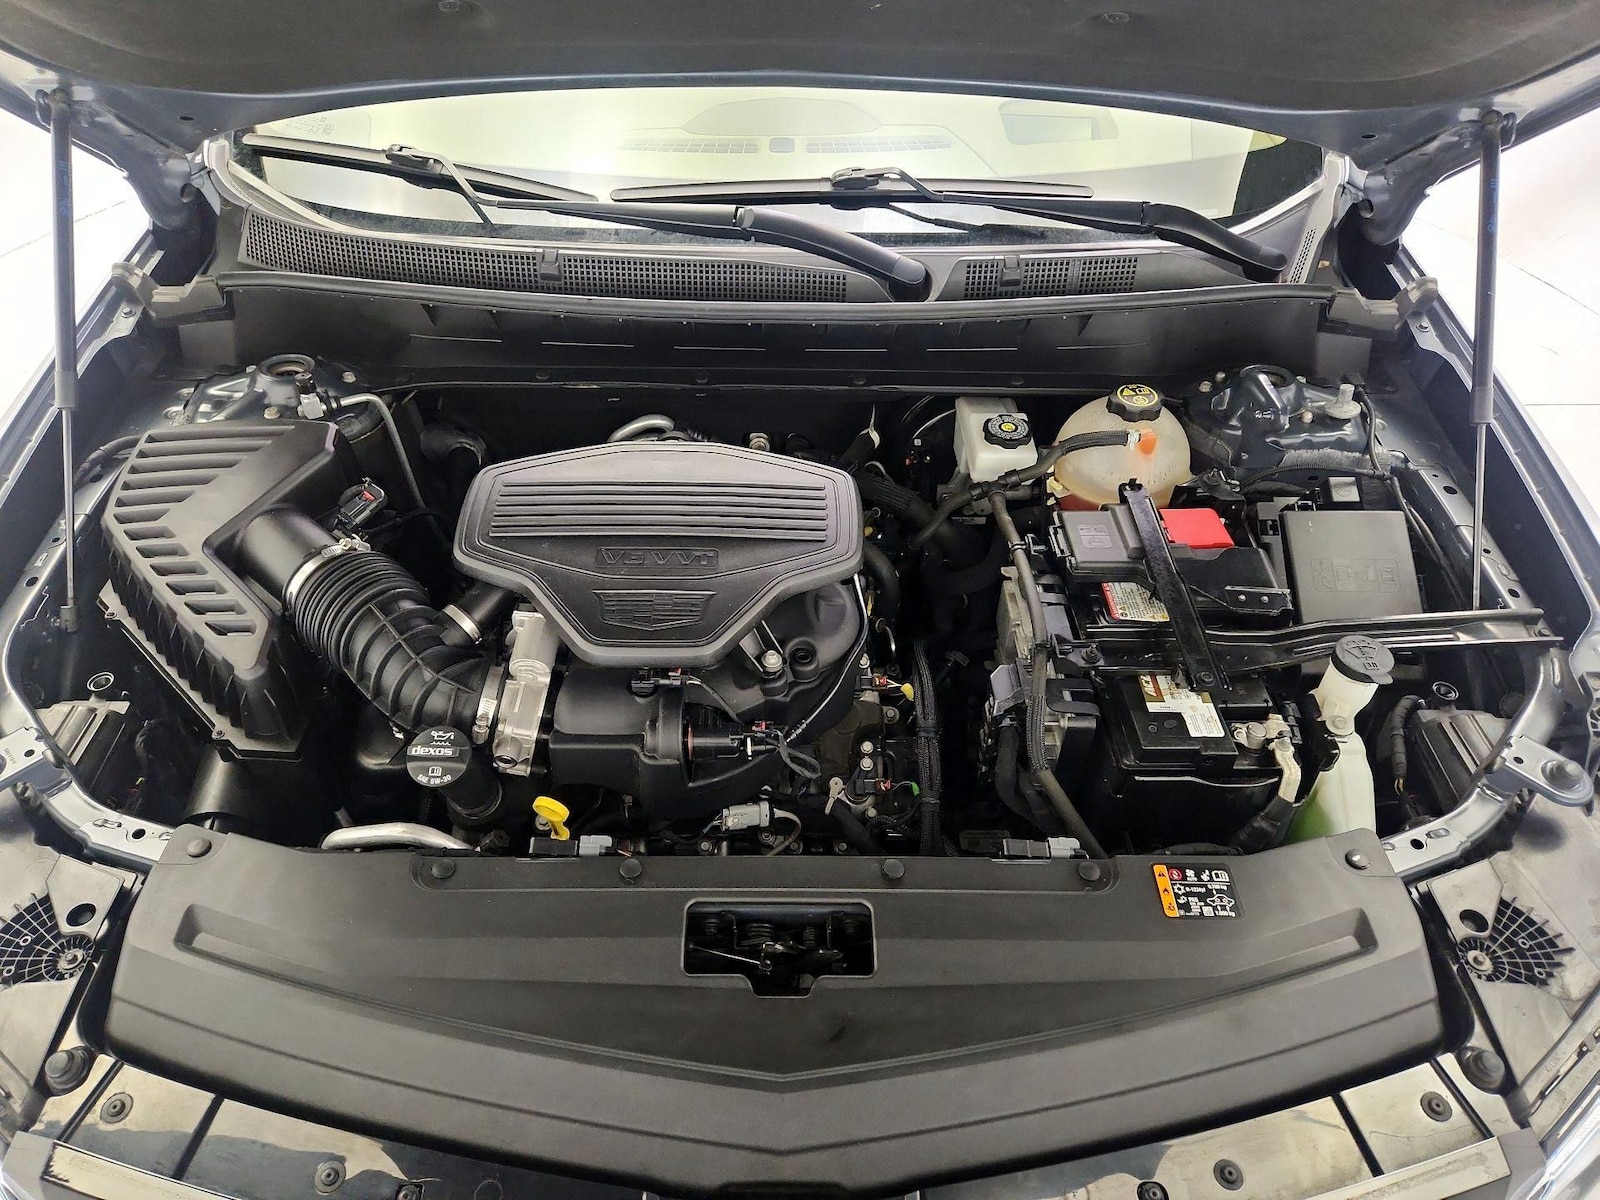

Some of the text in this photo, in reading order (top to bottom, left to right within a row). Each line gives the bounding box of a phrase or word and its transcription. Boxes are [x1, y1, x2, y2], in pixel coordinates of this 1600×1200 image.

[651, 551, 715, 565] VVT
[411, 745, 453, 756] dexos
[417, 774, 452, 785] SAE 5W-30
